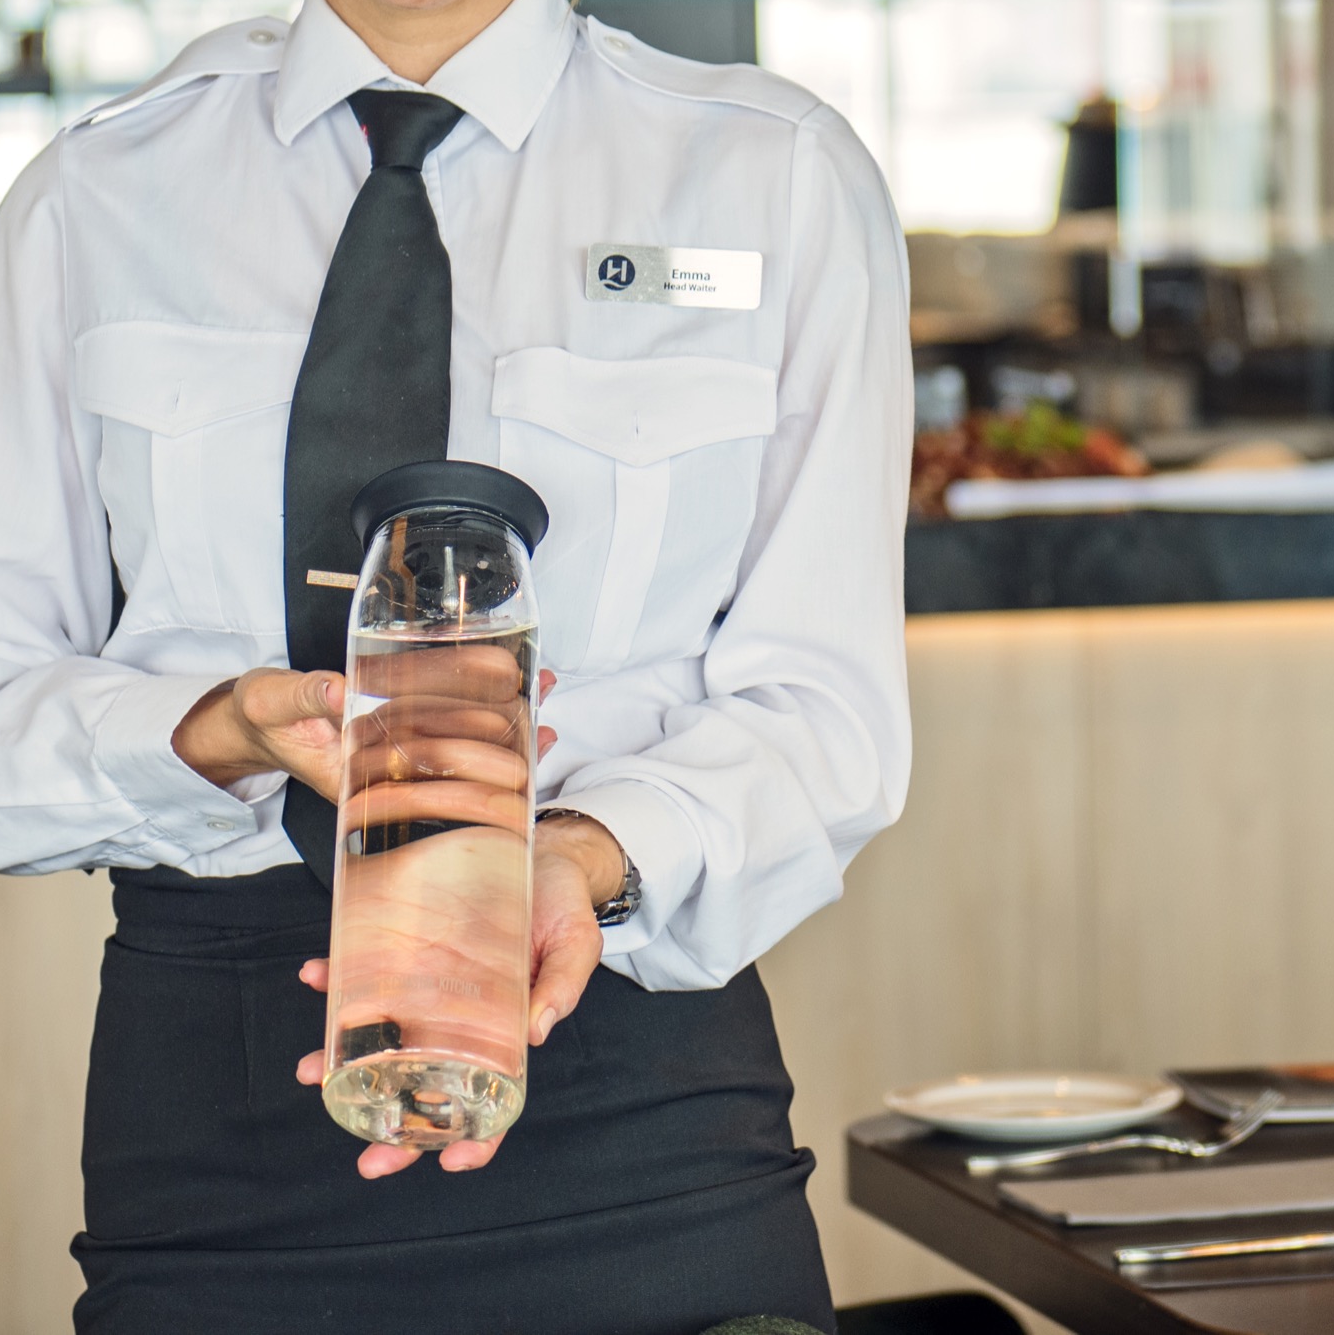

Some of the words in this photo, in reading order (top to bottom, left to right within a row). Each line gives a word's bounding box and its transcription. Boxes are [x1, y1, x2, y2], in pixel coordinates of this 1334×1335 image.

[672, 268, 711, 281] Emma
[663, 281, 687, 291] Head
[688, 283, 716, 293] Waiter
[437, 977, 481, 999] KITCHEN
